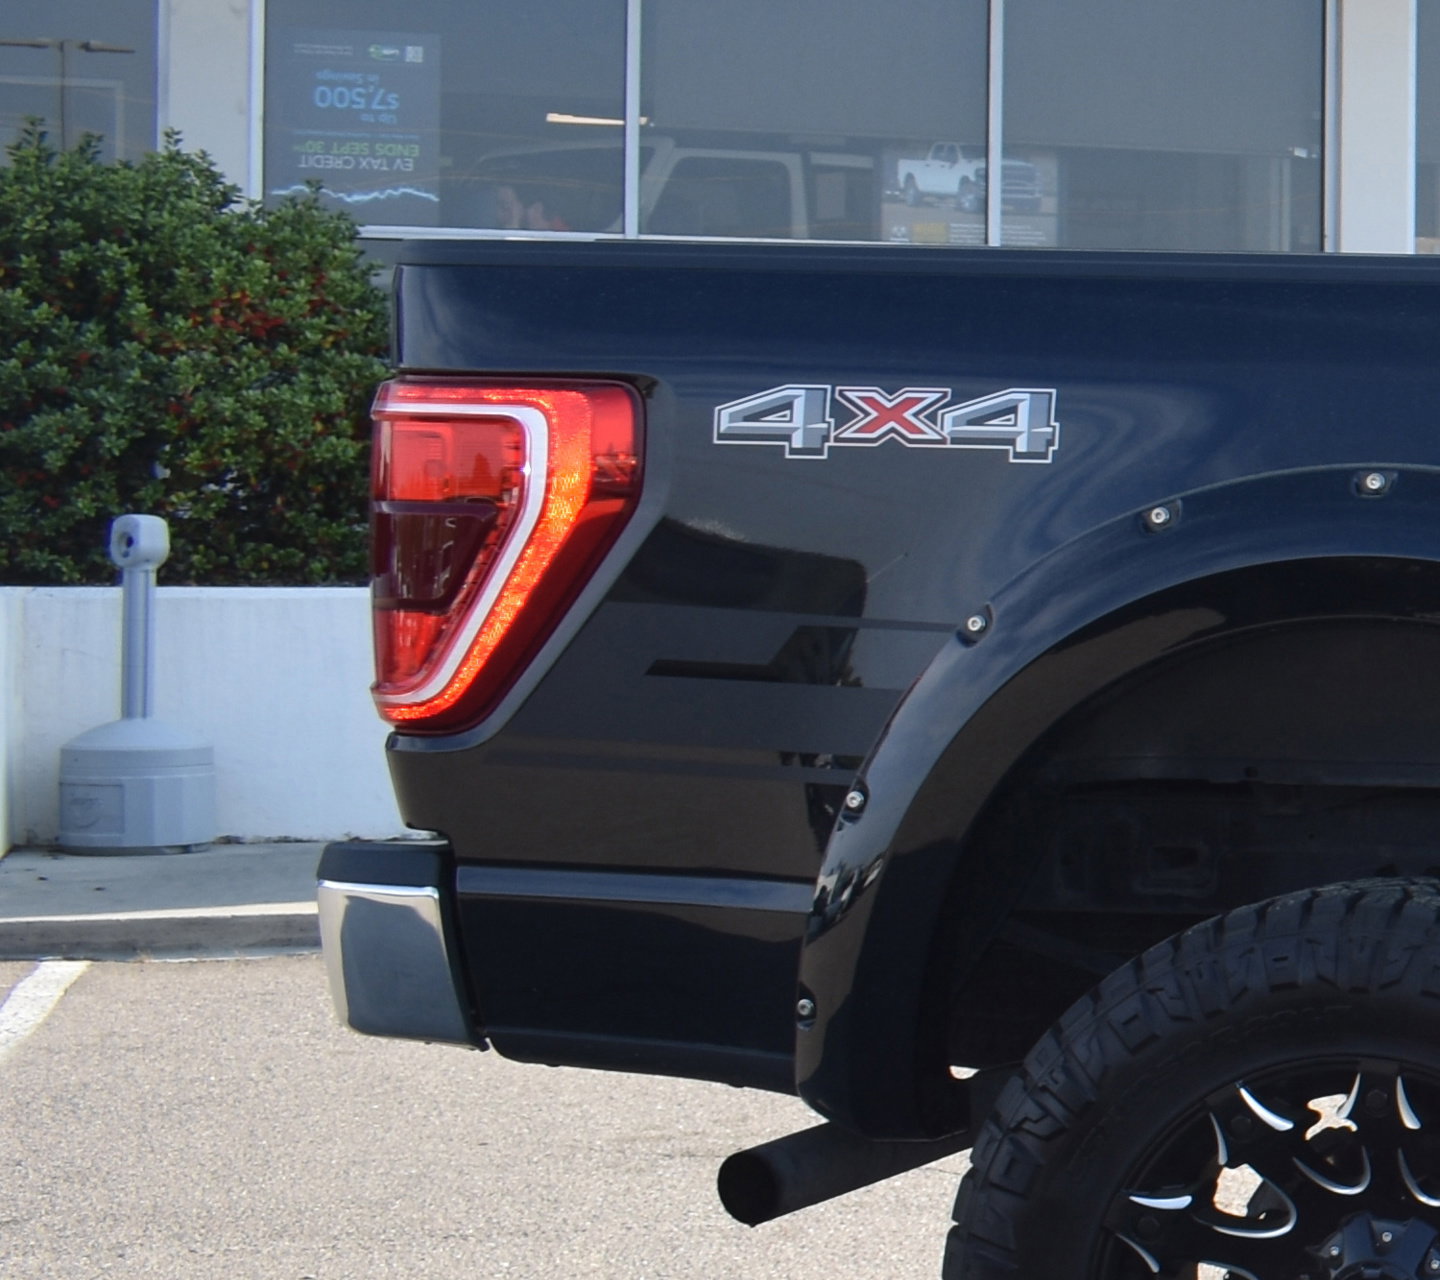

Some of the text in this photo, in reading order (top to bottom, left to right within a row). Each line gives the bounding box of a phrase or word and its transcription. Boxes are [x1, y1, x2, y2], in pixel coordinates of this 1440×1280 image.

[315, 85, 399, 110] $7,500
[330, 141, 370, 155] SEPT
[375, 143, 420, 157] ENDS
[298, 154, 414, 171] EV TAX CREDIT
